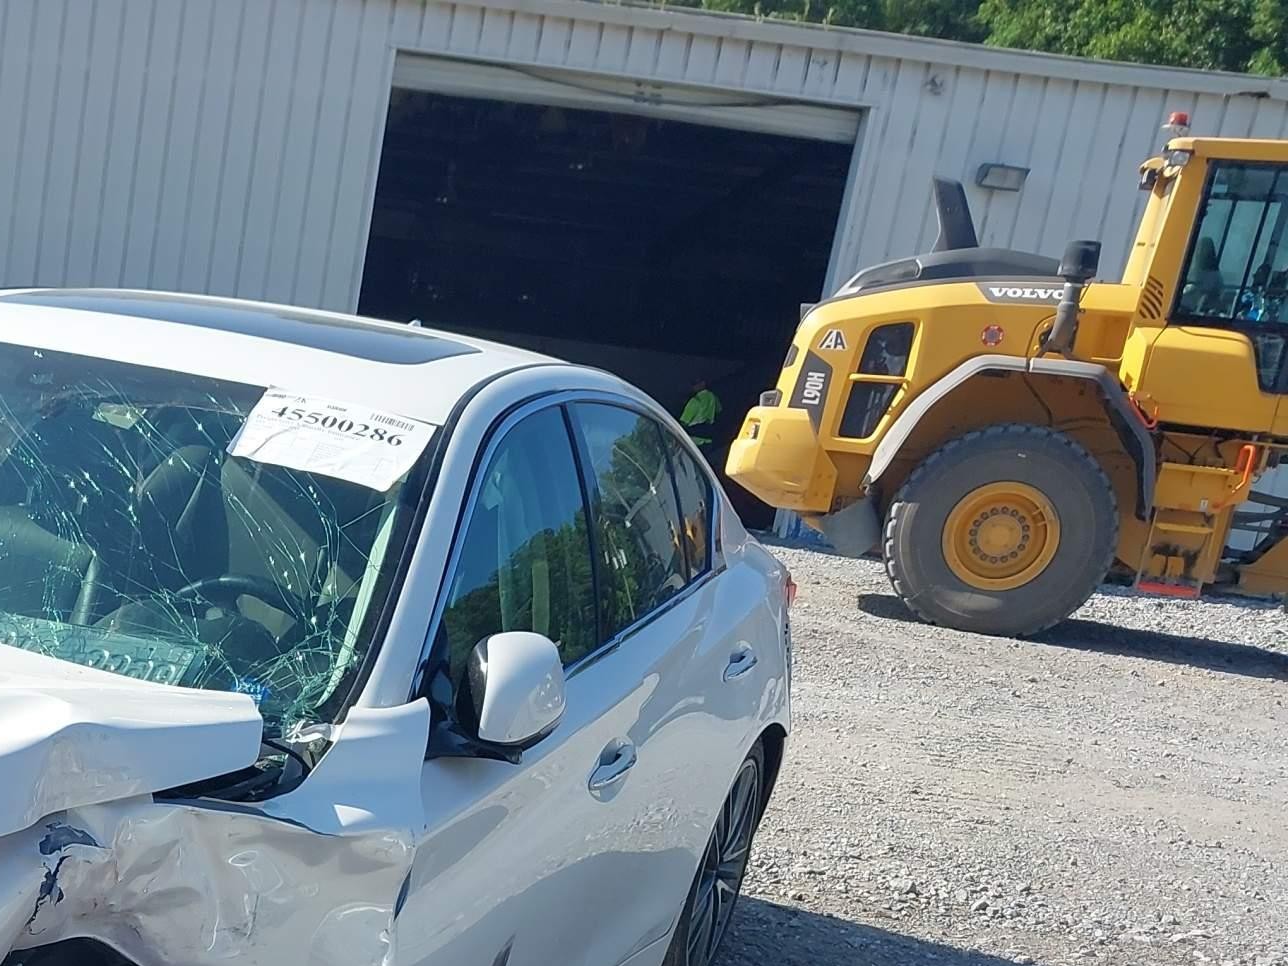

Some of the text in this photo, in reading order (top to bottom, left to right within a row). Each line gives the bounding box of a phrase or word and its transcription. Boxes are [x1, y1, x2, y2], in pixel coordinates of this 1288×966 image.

[989, 287, 1065, 300] VOLVO
[802, 371, 825, 405] L90H
[271, 405, 403, 447] 45500286
